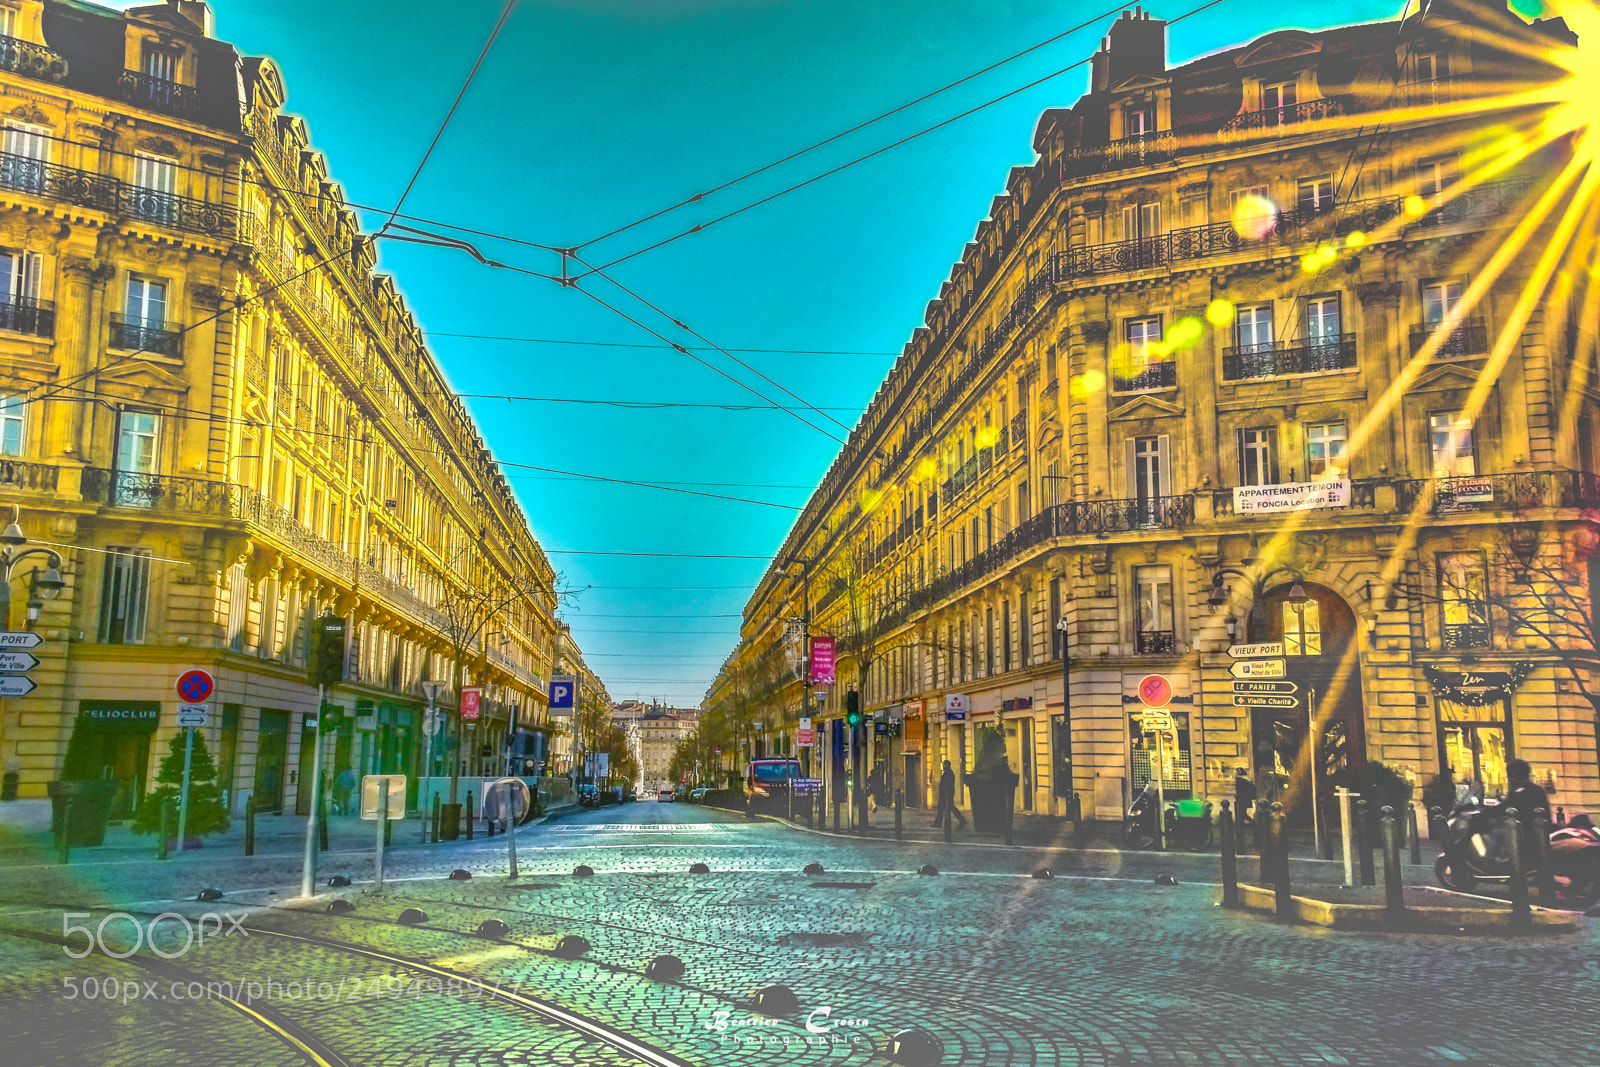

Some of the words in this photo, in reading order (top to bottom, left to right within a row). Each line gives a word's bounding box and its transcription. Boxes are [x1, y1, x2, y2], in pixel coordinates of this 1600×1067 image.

[1239, 485, 1305, 498] APPARTEMENT
[1307, 482, 1344, 493] TEMOIN
[1458, 485, 1491, 493] FONCIA
[1257, 500, 1290, 509] FONCIA
[1291, 497, 1325, 507] Location
[1, 635, 29, 645] PORT
[1235, 646, 1257, 655] VIEUX
[1260, 645, 1281, 654] PORT
[1461, 672, 1485, 686] Zen
